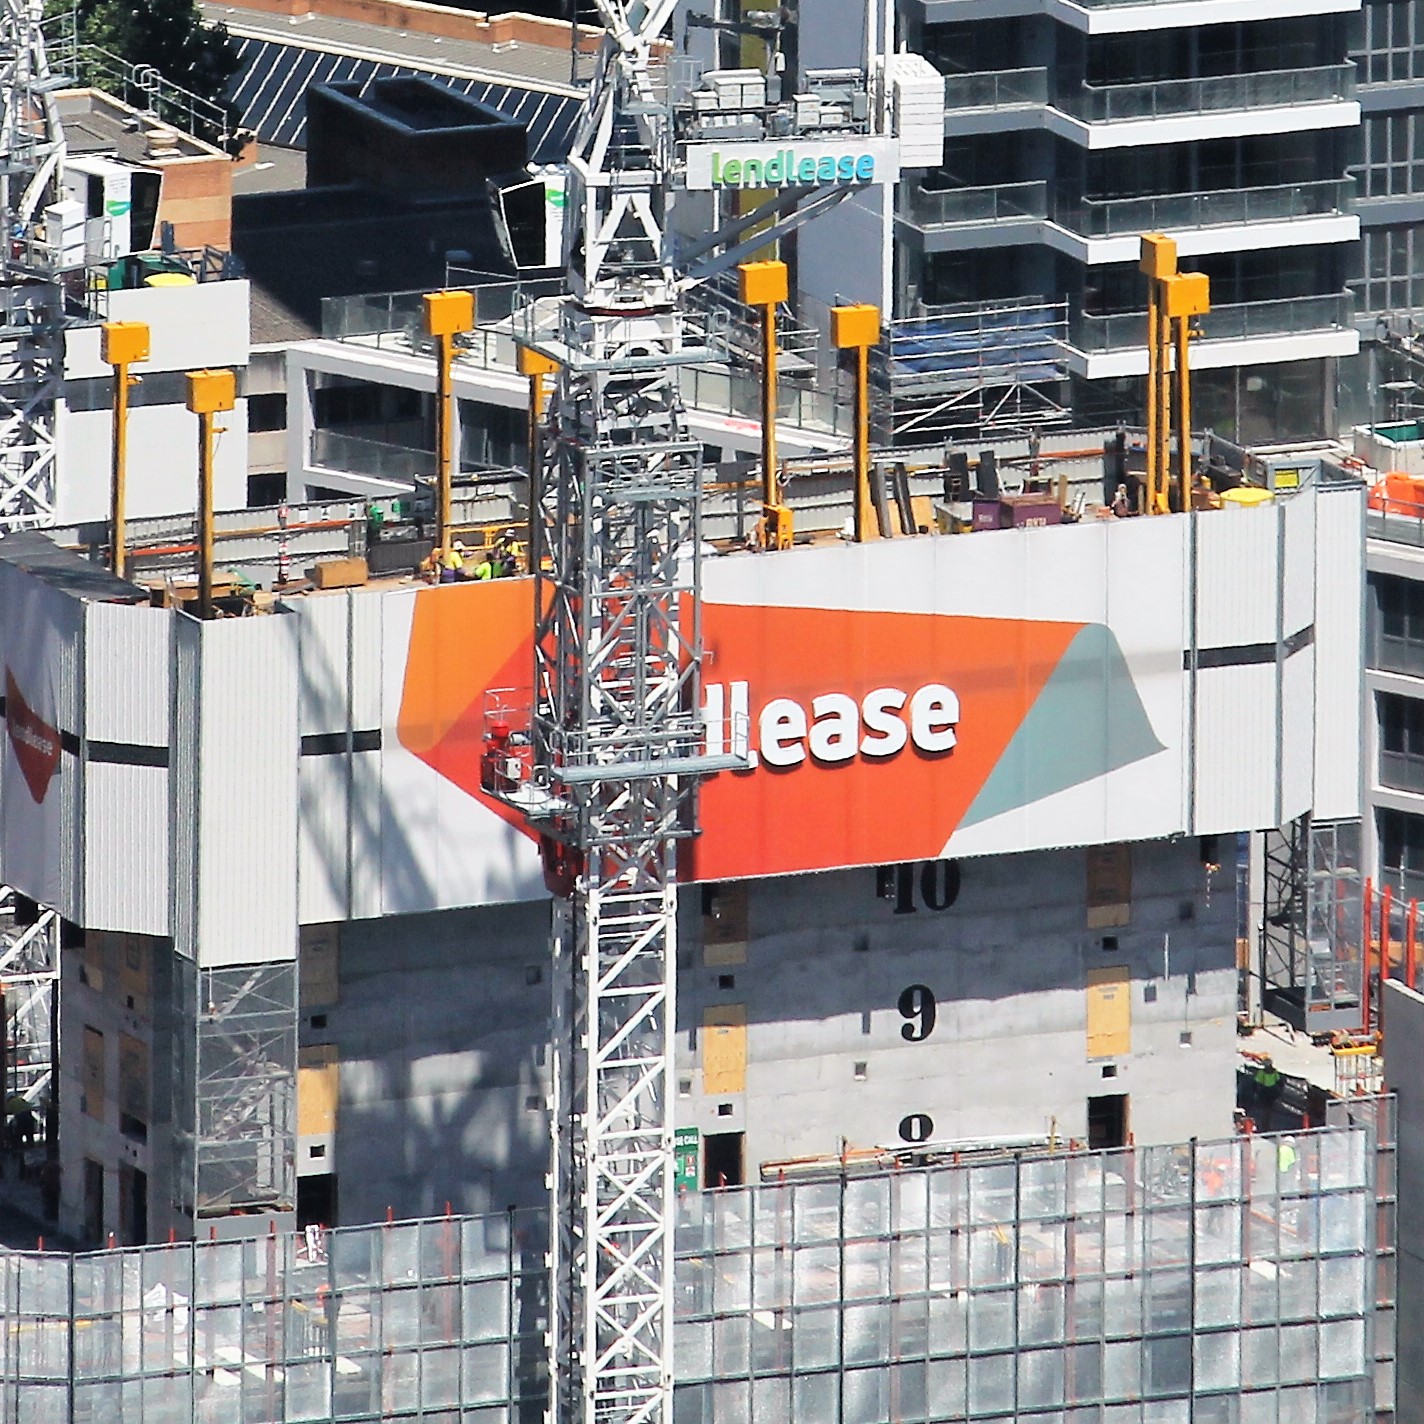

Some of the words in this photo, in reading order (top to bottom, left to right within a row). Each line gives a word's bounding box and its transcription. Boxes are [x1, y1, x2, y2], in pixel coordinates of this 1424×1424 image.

[712, 150, 874, 184] lendlease
[893, 860, 961, 914] 10
[897, 984, 937, 1043] 9
